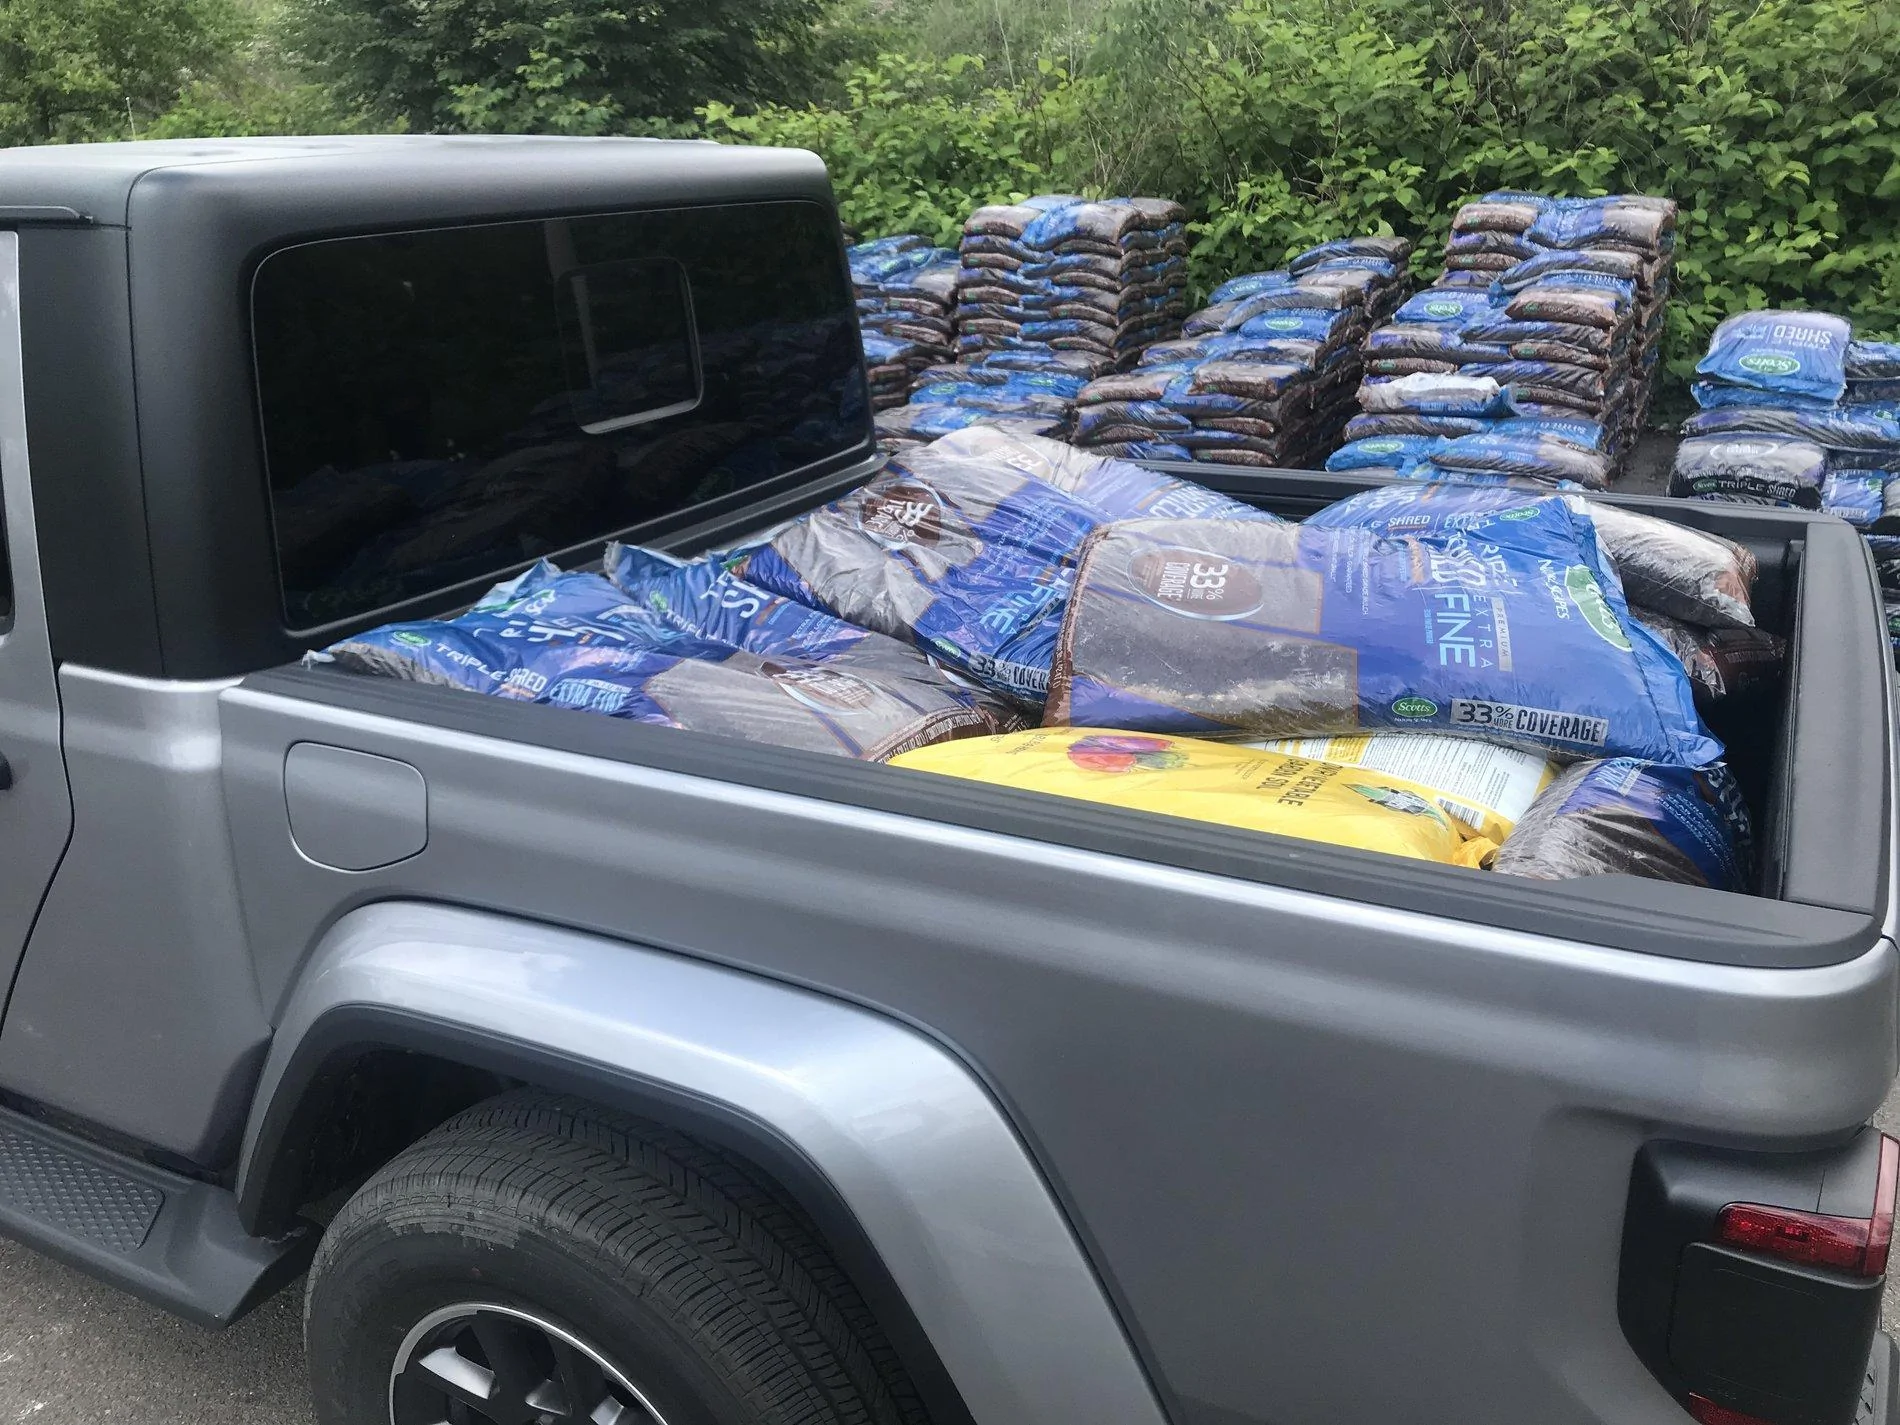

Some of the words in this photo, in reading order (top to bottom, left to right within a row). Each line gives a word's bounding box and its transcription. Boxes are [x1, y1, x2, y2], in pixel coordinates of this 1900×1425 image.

[1774, 325, 1832, 345] SHRED
[1718, 479, 1765, 491] TRIPLE
[1387, 514, 1431, 528] SHRED
[1189, 563, 1229, 600] 33%
[1434, 593, 1476, 668] FINE
[1473, 594, 1495, 669] EXTRA
[1496, 606, 1510, 657] PREMIUM
[436, 642, 506, 681] TRIPLE
[504, 667, 548, 693] SHRED
[1013, 664, 1048, 692] COVER
[550, 681, 592, 706] EXTRA
[1398, 701, 1431, 713] Scotts
[1457, 702, 1514, 724] 33%
[1515, 709, 1602, 743] COVERAGE
[1493, 717, 1514, 729] MORE
